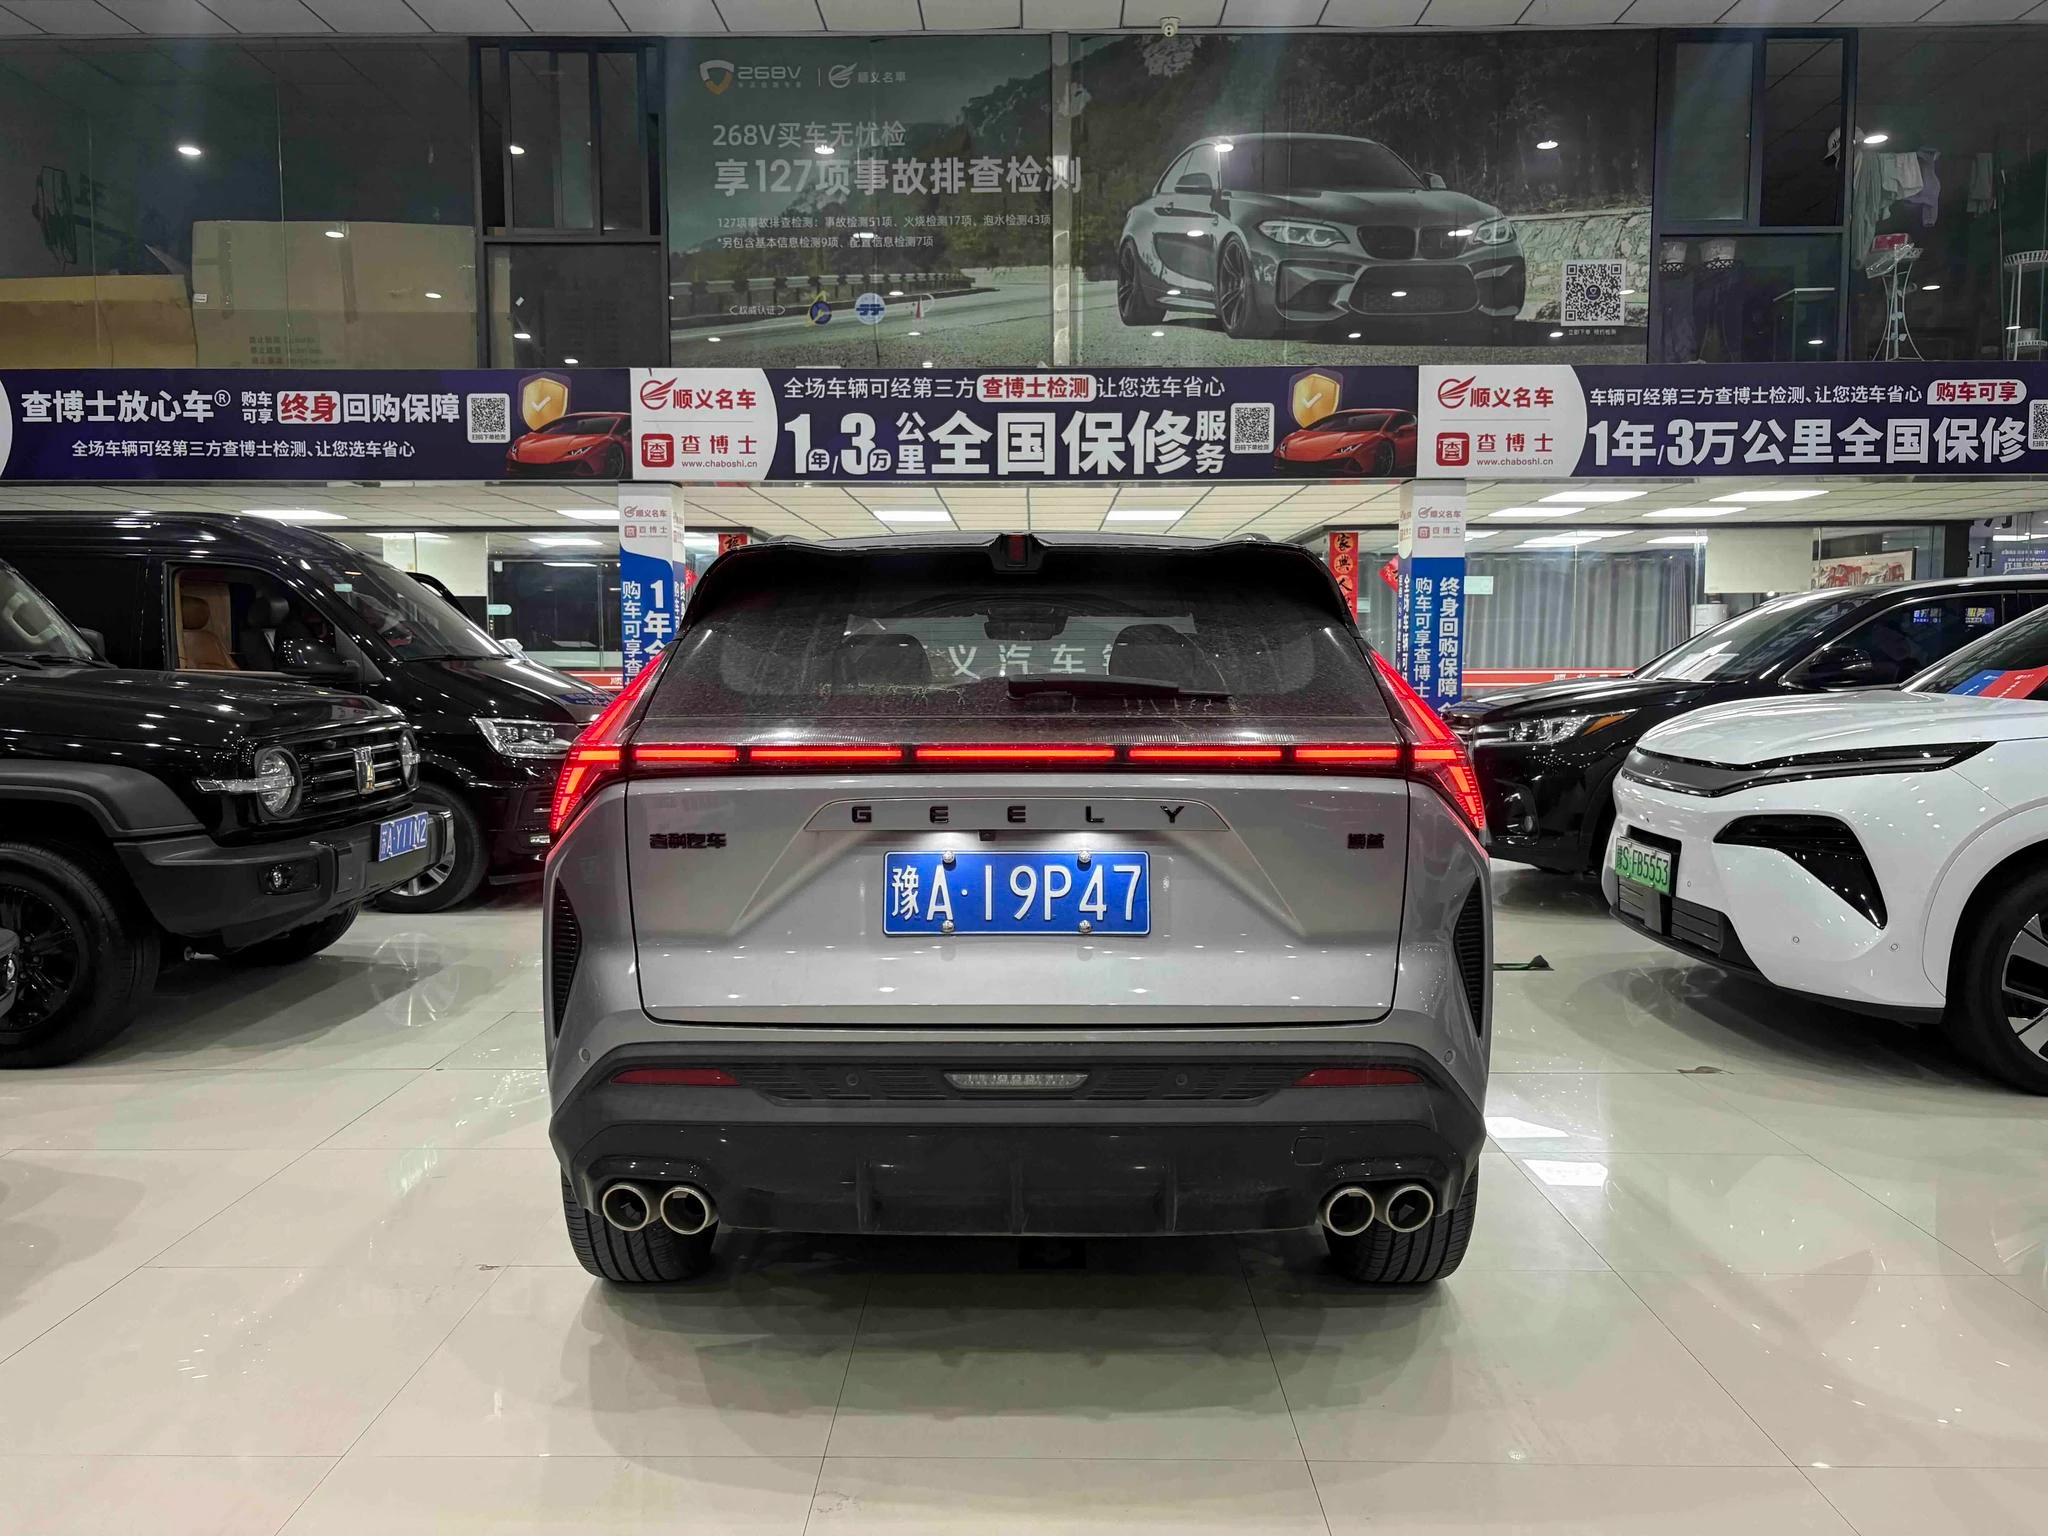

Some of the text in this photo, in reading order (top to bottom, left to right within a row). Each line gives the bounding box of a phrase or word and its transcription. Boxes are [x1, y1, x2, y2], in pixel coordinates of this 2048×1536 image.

[738, 66, 801, 80] 268V
[712, 121, 907, 147] 268V买车无忧检
[714, 156, 1081, 197] 享127项事故排查检测
[241, 391, 272, 407] 购车
[673, 388, 757, 410] 顺义名车
[1470, 387, 1554, 408] 顺义名车
[1936, 382, 2018, 402] 购车可享
[242, 408, 273, 424] 可享
[681, 434, 757, 455] 查博士
[1477, 433, 1554, 453] 查博士
[681, 459, 757, 468] www.chaboshi.cn
[1476, 457, 1554, 466] www.chaboshi.cn
[1336, 533, 1354, 611] 家興人
[1413, 577, 1433, 699] 购车可享查博士
[851, 805, 1185, 824] GEELY
